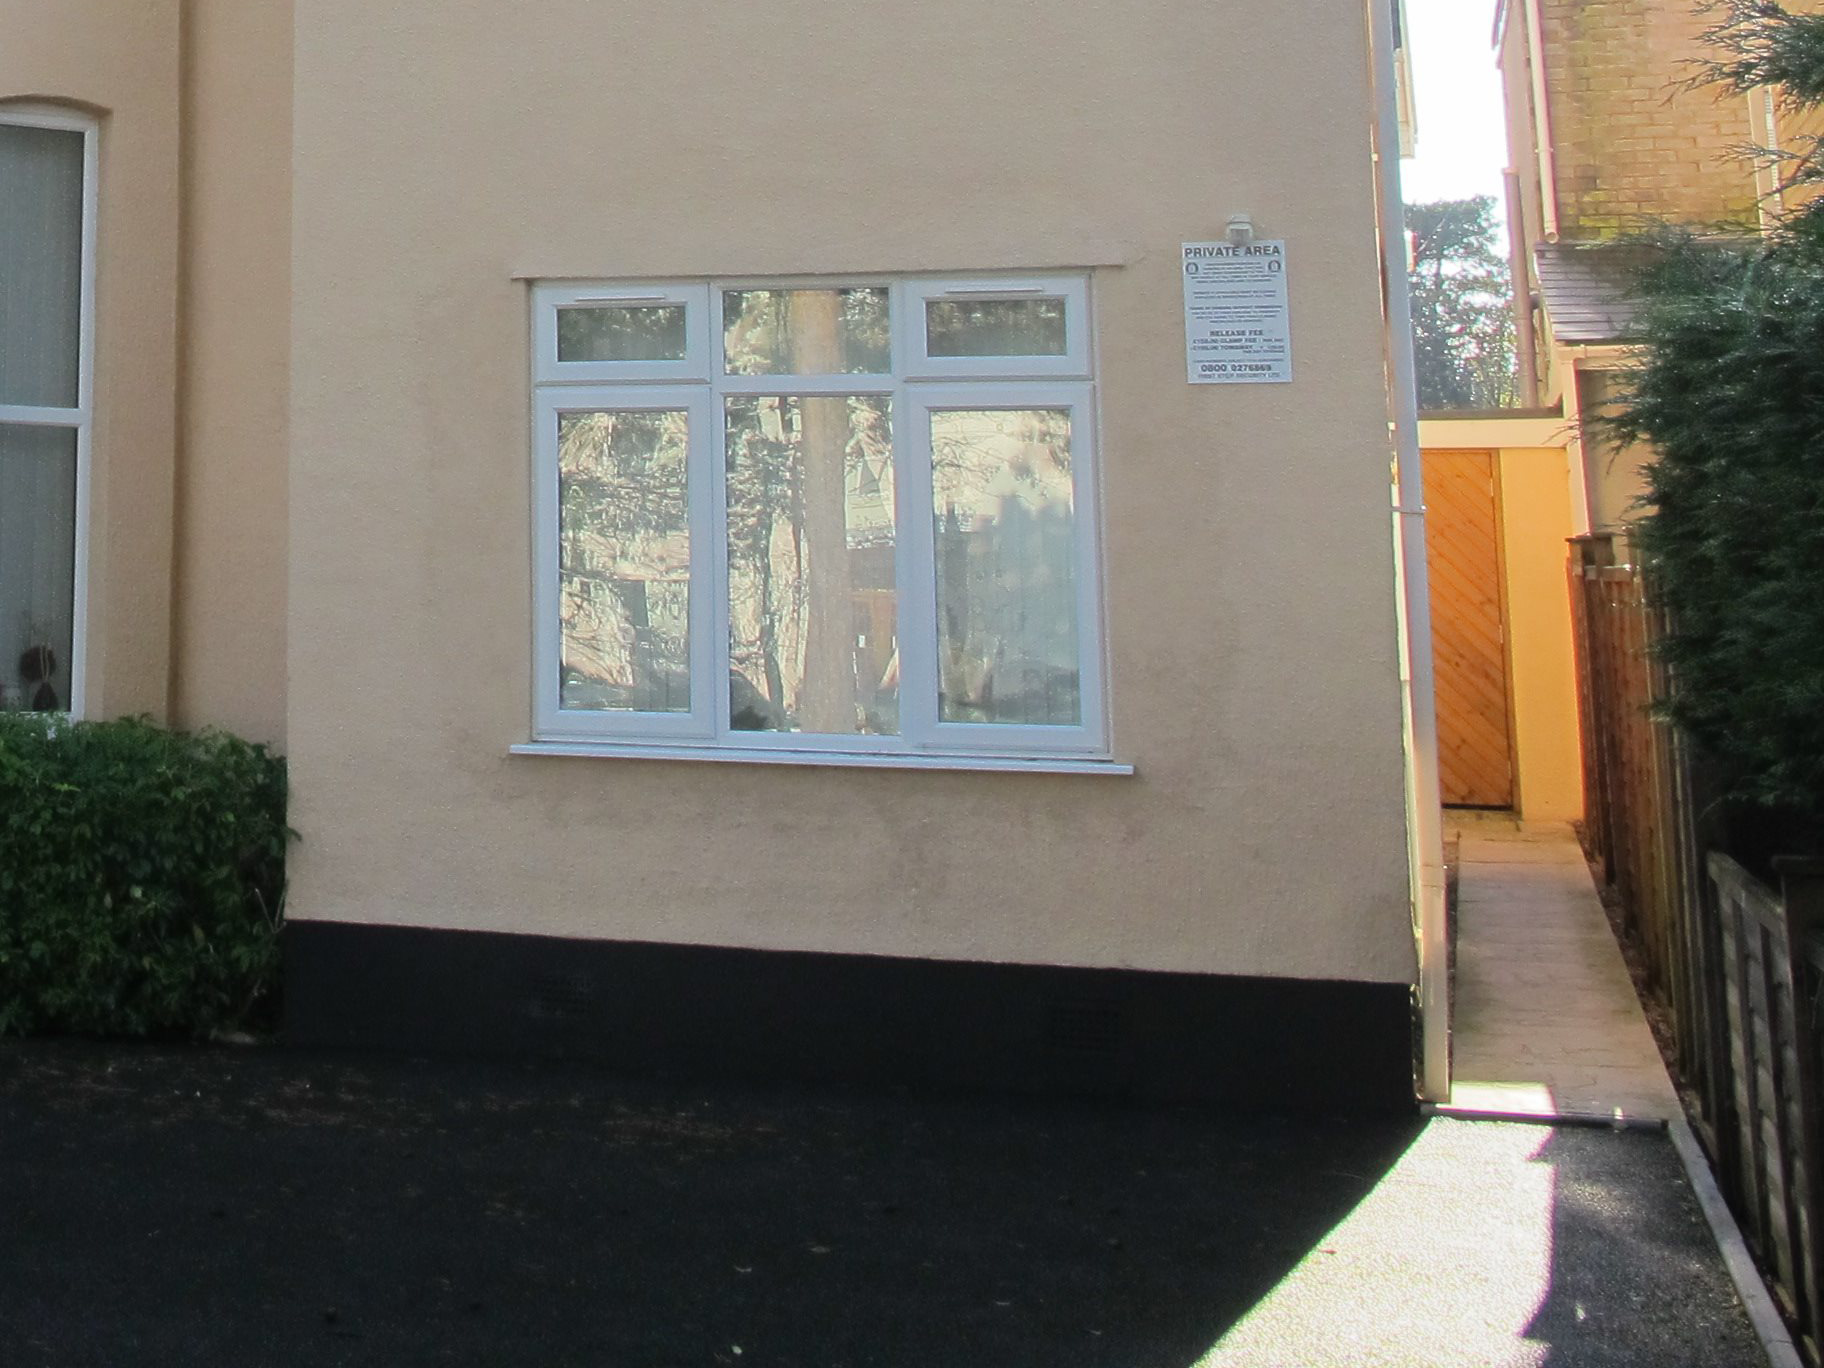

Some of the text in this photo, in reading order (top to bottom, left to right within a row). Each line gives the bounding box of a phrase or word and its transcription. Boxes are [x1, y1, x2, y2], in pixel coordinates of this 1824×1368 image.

[1184, 245, 1281, 257] PRIVATE AREA
[1209, 329, 1246, 337] RELEASE
[1201, 363, 1227, 372] 0800
